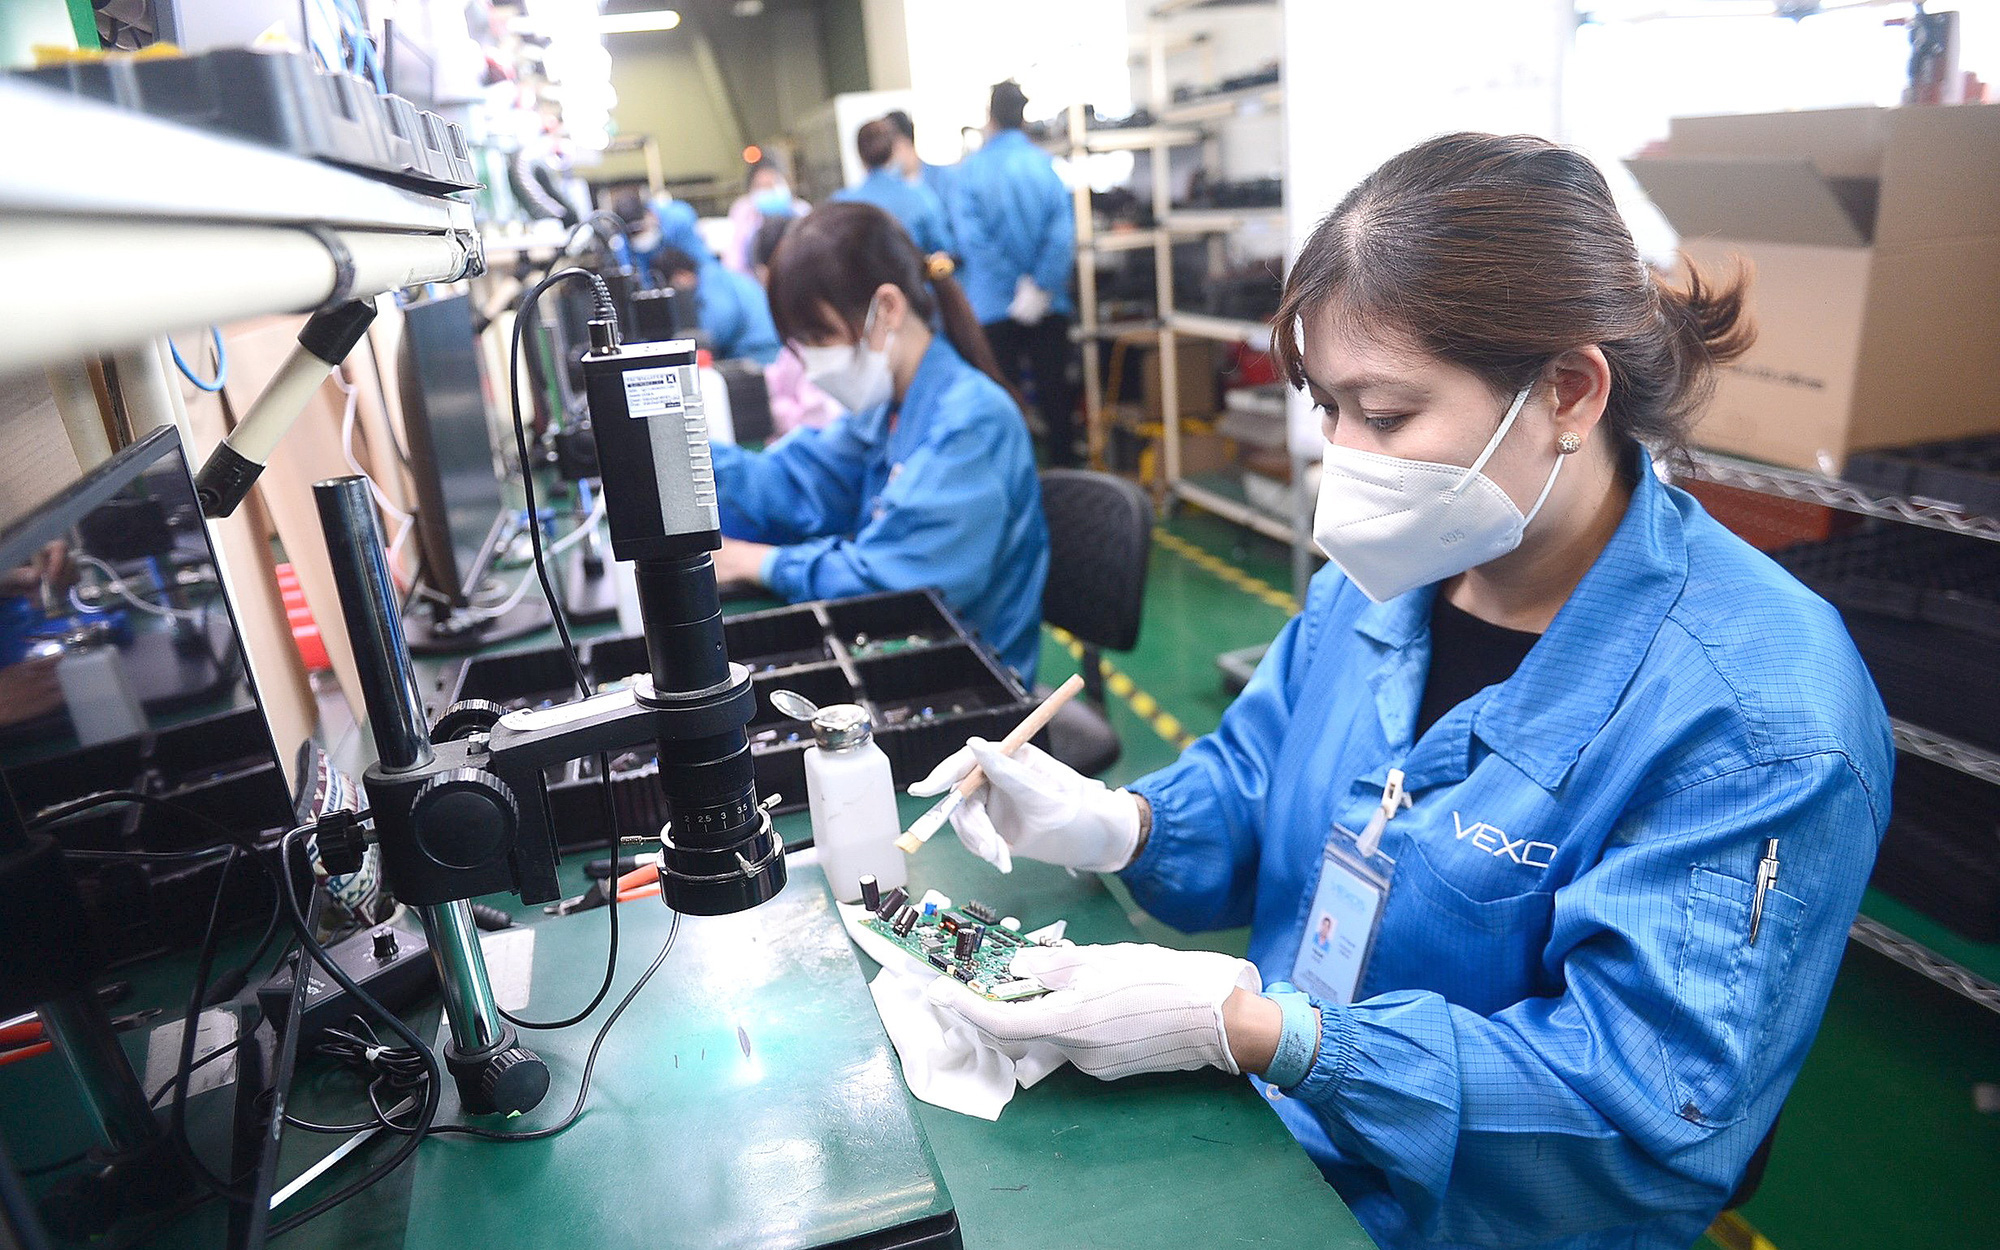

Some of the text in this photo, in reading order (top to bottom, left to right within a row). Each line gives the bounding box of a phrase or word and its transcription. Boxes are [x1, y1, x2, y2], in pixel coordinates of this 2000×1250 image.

[684, 815, 691, 823] 2
[697, 814, 712, 823] 2.5
[720, 811, 727, 820] 3
[1452, 810, 1558, 869] VEXO
